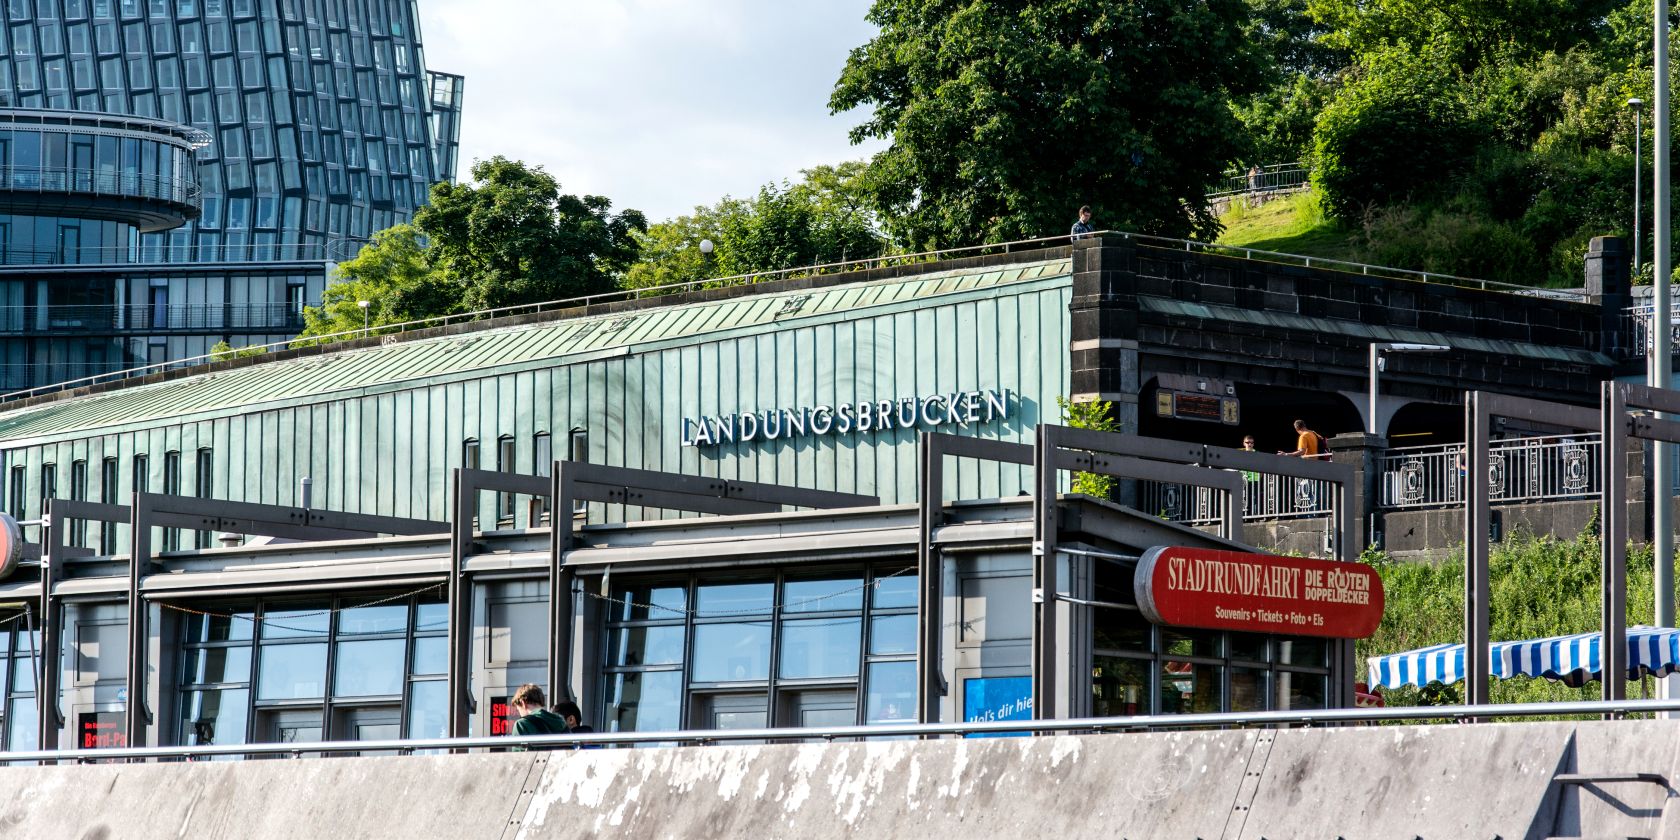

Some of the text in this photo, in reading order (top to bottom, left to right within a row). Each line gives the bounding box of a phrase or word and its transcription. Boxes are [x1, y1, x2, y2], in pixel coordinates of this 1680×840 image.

[680, 388, 1011, 447] LANDUNGSBRÜCKEN
[1167, 556, 1301, 600] STADTRUNDFAHRT
[1304, 568, 1323, 587] DIE
[1304, 587, 1370, 605] DOPPELDECKER
[1215, 605, 1324, 626] Souvenirs Tickets Foto Eis
[997, 703, 1014, 719] dir
